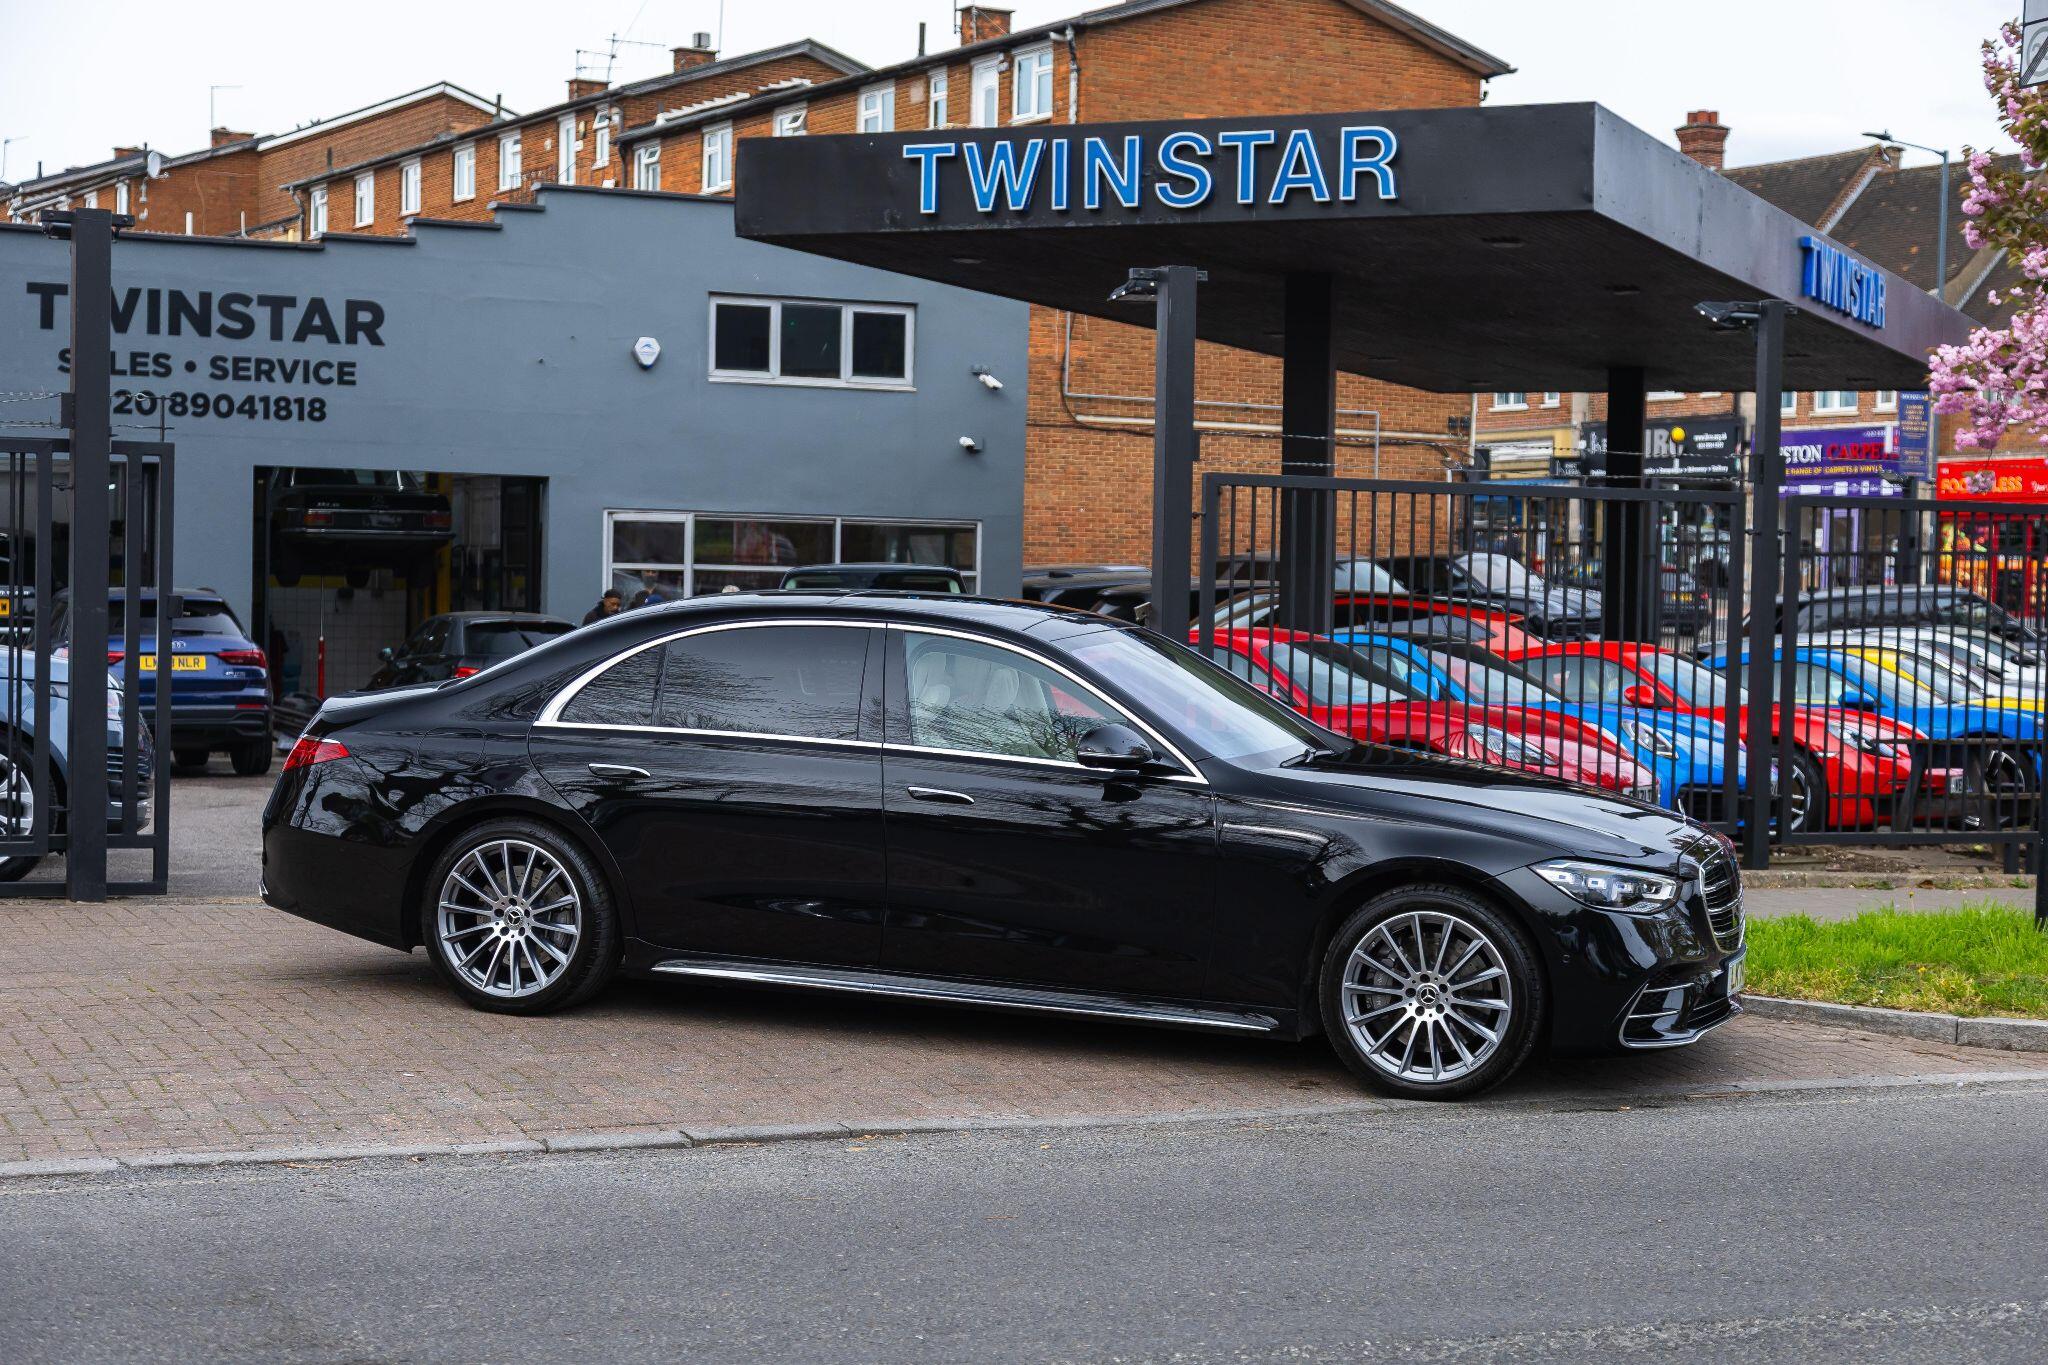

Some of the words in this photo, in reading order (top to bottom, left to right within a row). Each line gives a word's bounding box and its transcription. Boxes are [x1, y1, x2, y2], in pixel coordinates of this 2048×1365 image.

[902, 125, 1398, 214] TWINSTAR
[1801, 235, 1887, 328] TWINSTAR
[57, 347, 172, 378] SLES
[208, 354, 358, 387] SERVICE
[110, 388, 157, 416] 20
[167, 390, 327, 423] 89041818
[1779, 444, 1822, 464] STON
[178, 657, 200, 668] NLR
